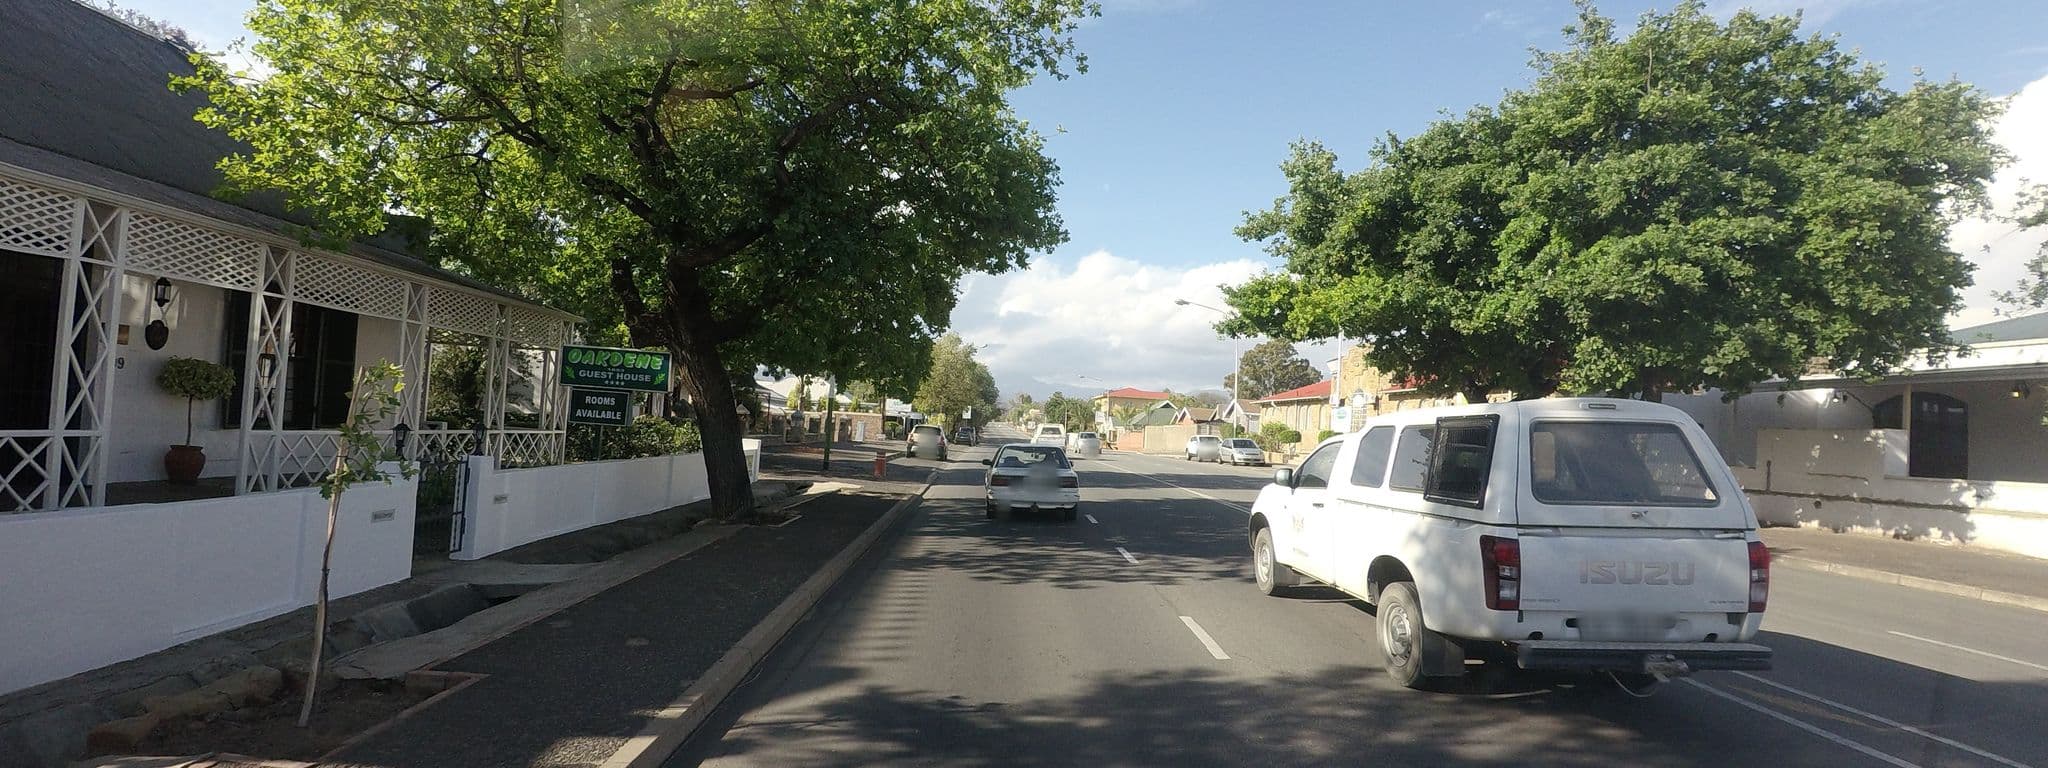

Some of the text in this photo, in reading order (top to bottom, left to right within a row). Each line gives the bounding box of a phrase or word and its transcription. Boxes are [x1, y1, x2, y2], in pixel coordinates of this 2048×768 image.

[567, 348, 664, 370] OAKDENE
[578, 369, 614, 380] GUEST
[616, 371, 652, 382] HOUSE
[585, 396, 616, 406] ROOMS
[575, 409, 622, 420] AVAILABLE
[1579, 560, 1695, 585] ISUZU
